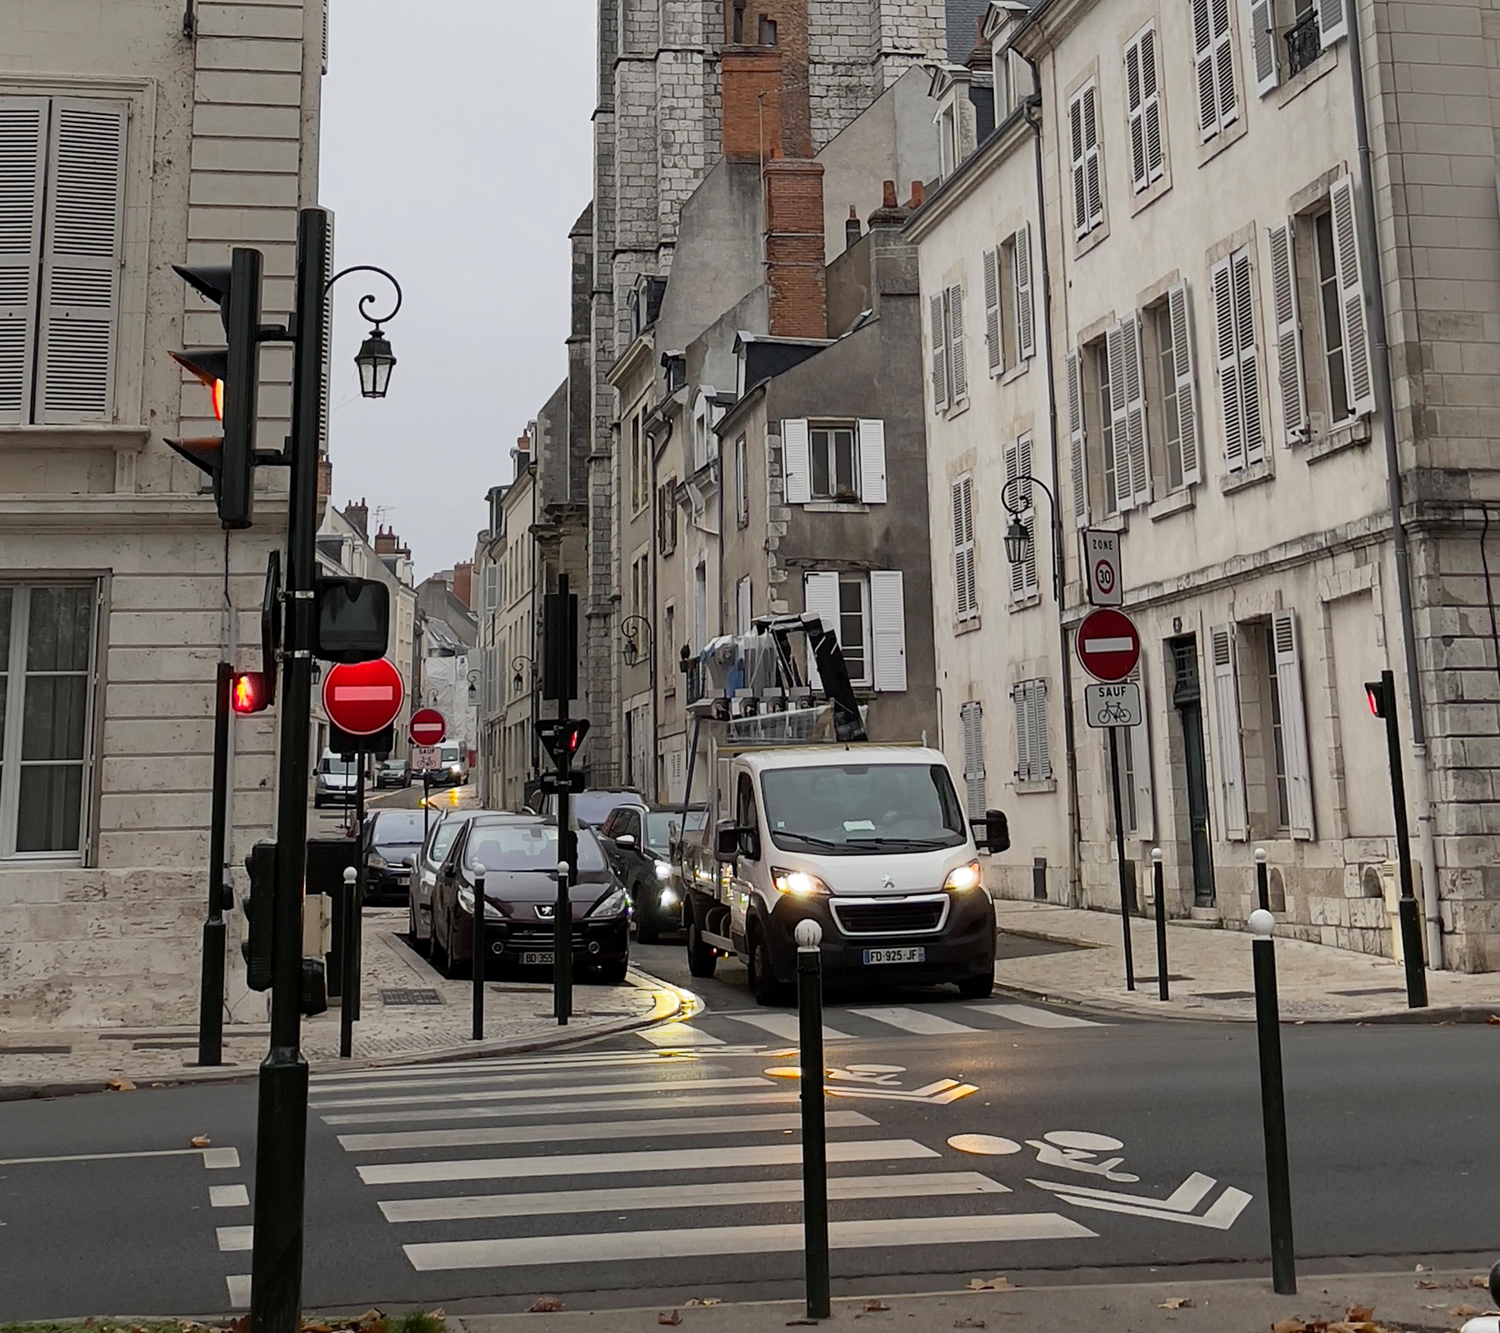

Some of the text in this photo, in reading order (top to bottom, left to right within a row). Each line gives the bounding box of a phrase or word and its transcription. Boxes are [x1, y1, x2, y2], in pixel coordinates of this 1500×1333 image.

[1092, 539, 1113, 550] ZONE
[1099, 569, 1111, 584] 30
[1098, 686, 1126, 697] SAUF
